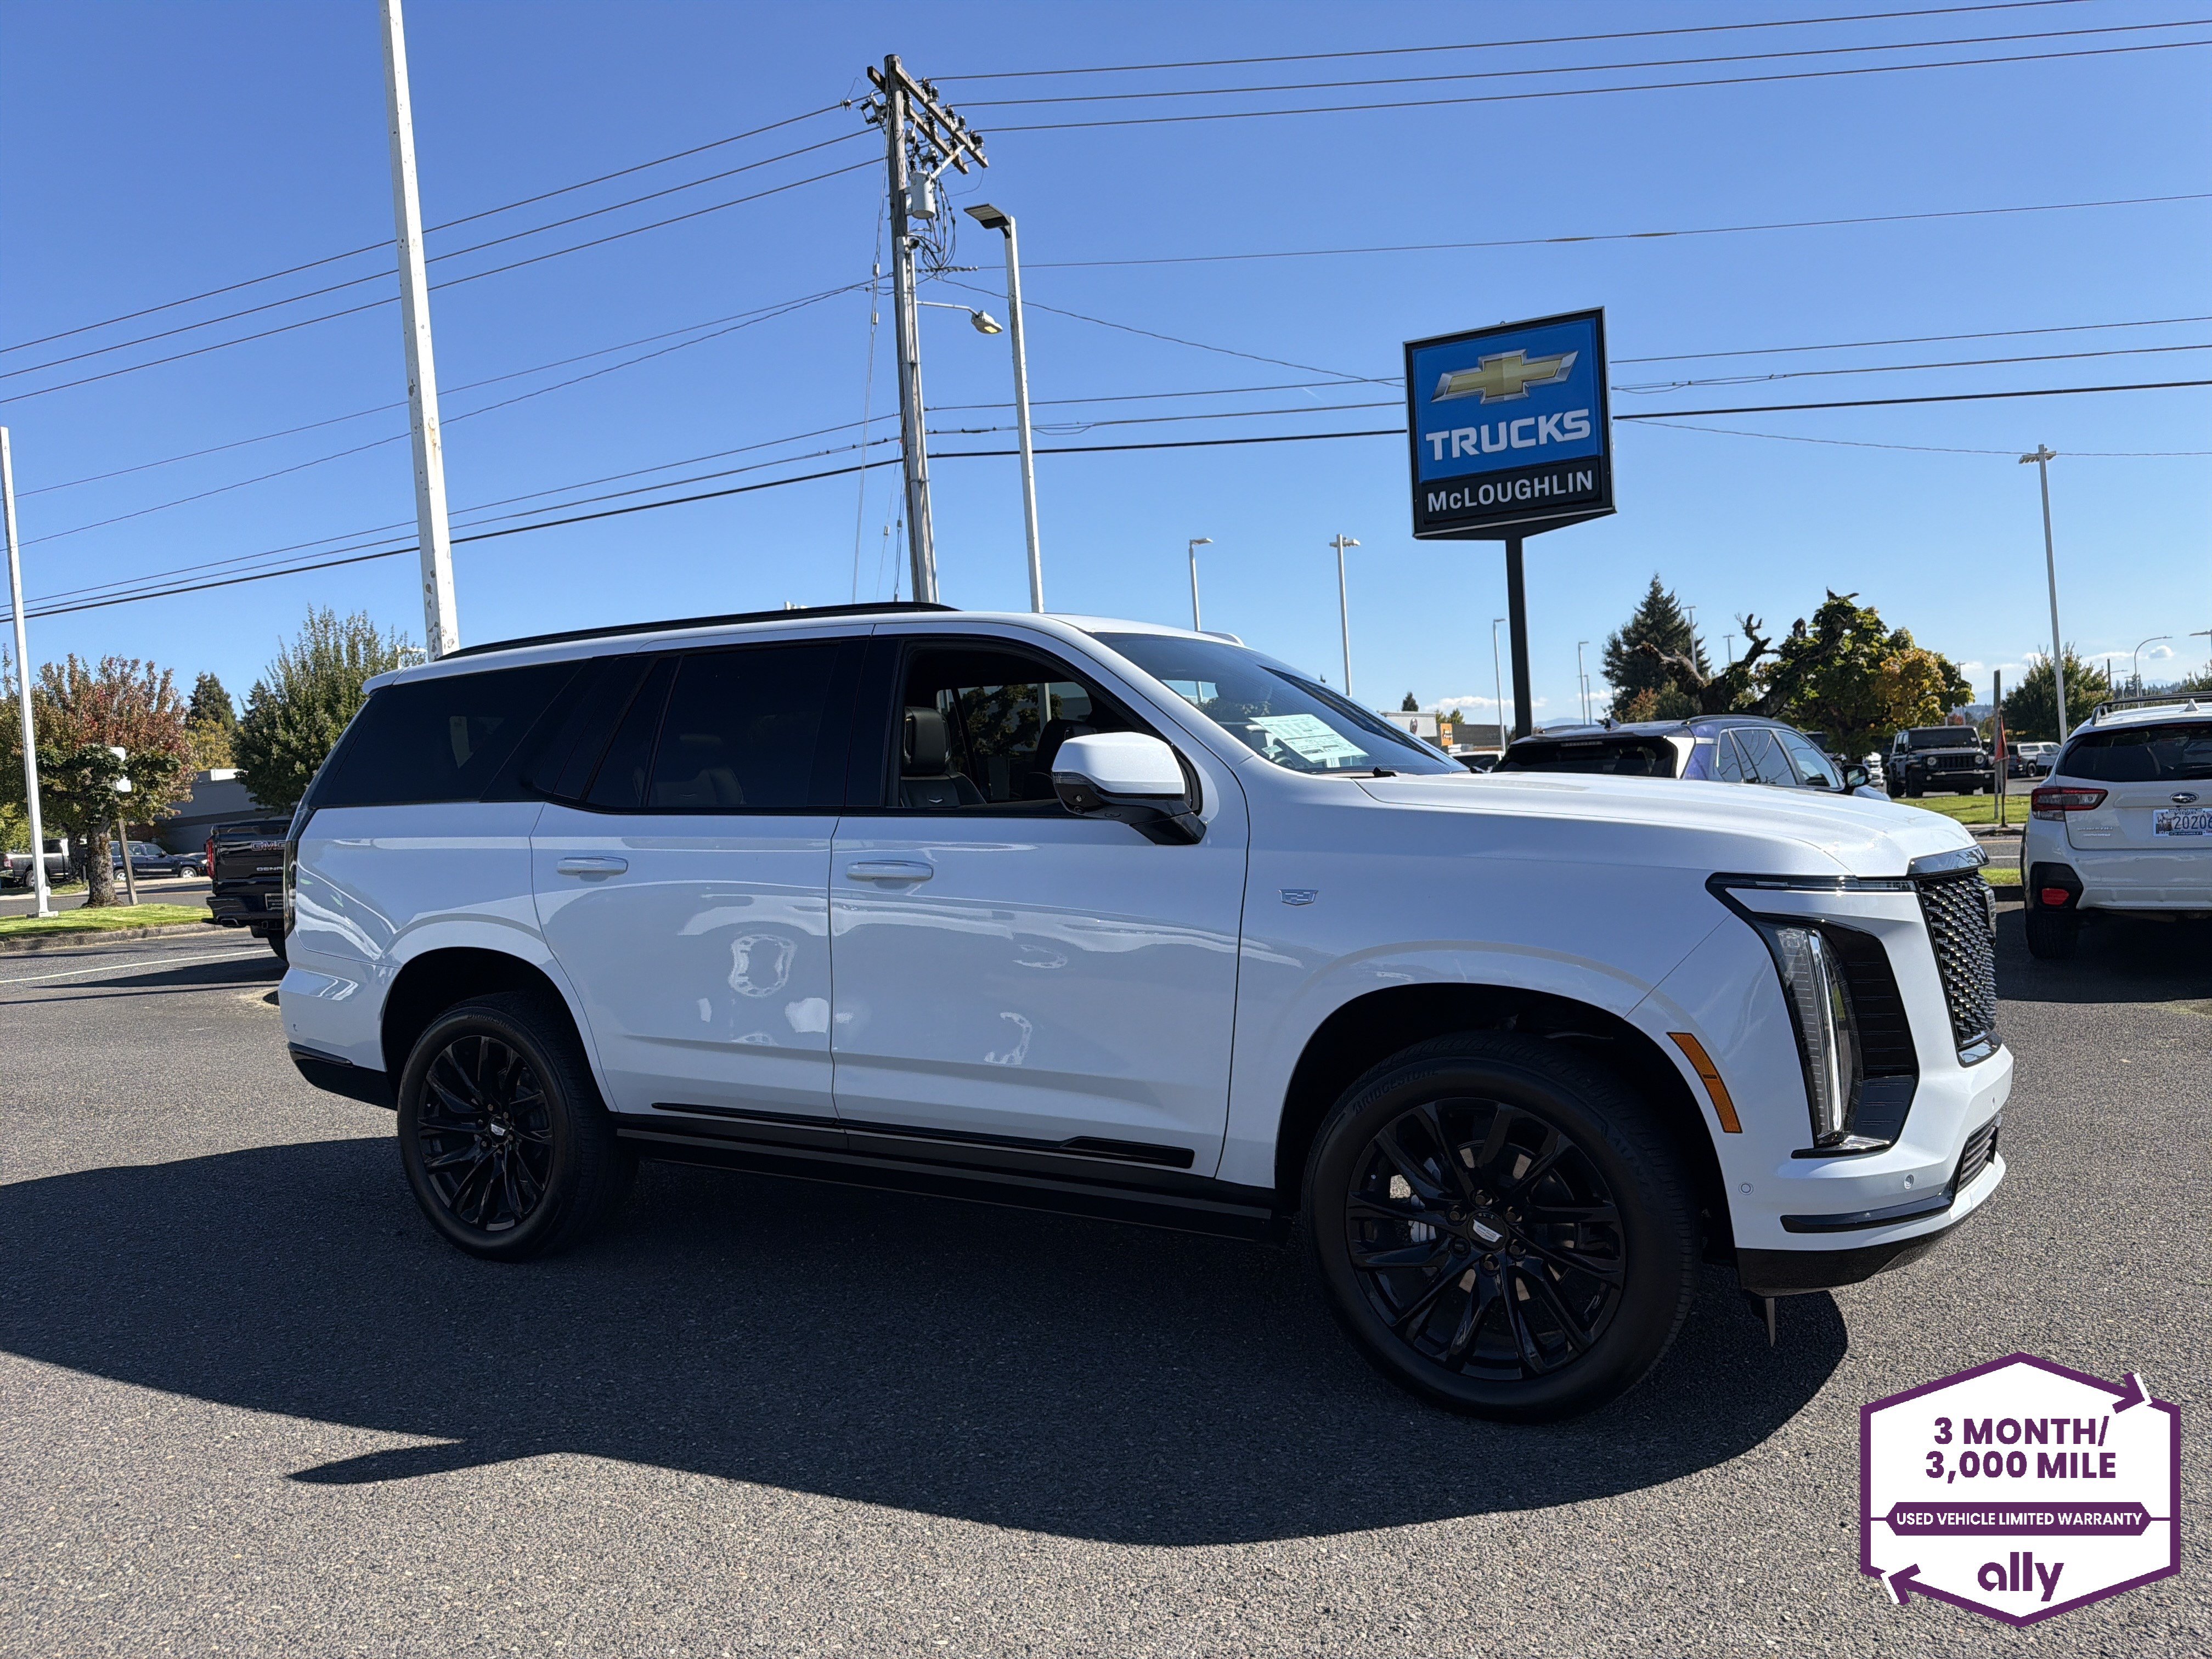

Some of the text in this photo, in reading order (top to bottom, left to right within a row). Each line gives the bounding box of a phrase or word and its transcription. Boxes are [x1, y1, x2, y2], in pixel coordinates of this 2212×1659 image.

[1426, 409, 1590, 461] TRUCKS
[1428, 470, 1593, 513] McLOUGHLIN
[251, 841, 285, 851] GMC
